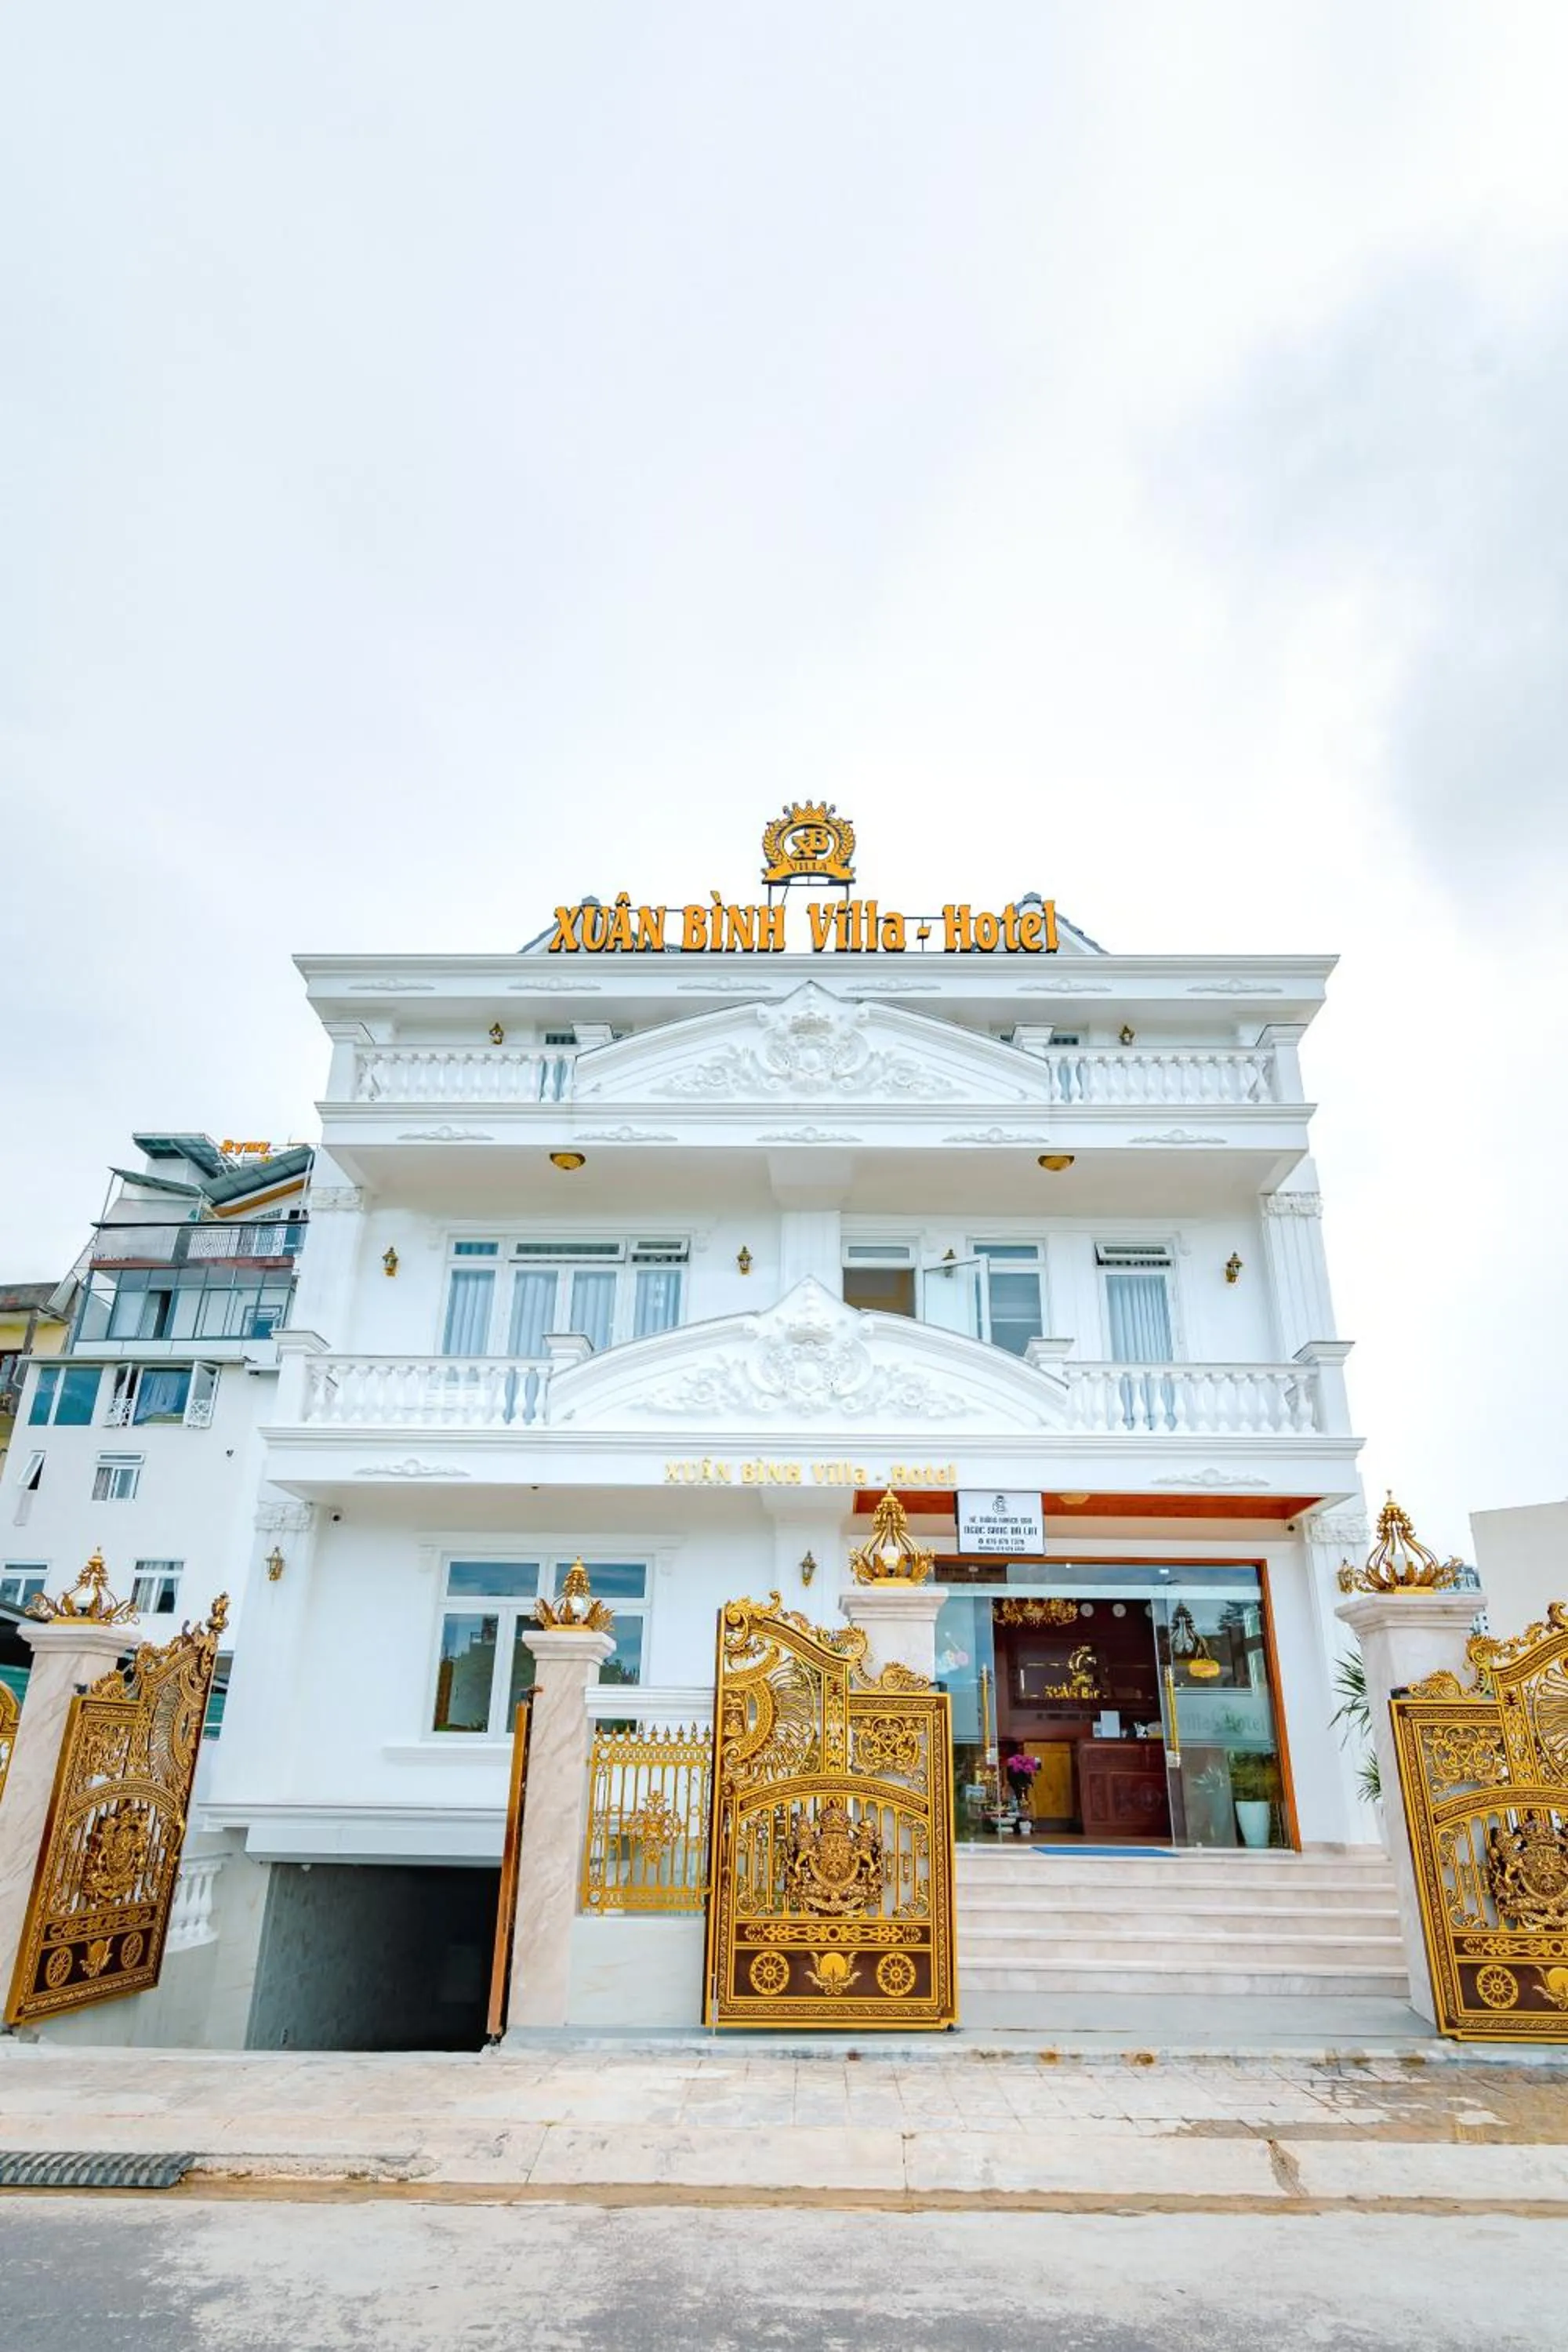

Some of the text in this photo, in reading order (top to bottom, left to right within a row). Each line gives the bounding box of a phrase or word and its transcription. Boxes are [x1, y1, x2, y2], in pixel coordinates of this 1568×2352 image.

[788, 862, 828, 872] VILLA
[548, 891, 666, 953] XUÂN
[681, 890, 786, 953] BÌNH
[806, 899, 907, 953] Villa
[942, 899, 1060, 953] Hotel
[665, 1457, 732, 1484] XUÂN
[741, 1457, 801, 1484] BÌNH
[811, 1461, 867, 1485] Villa
[891, 1464, 956, 1486] Hotel
